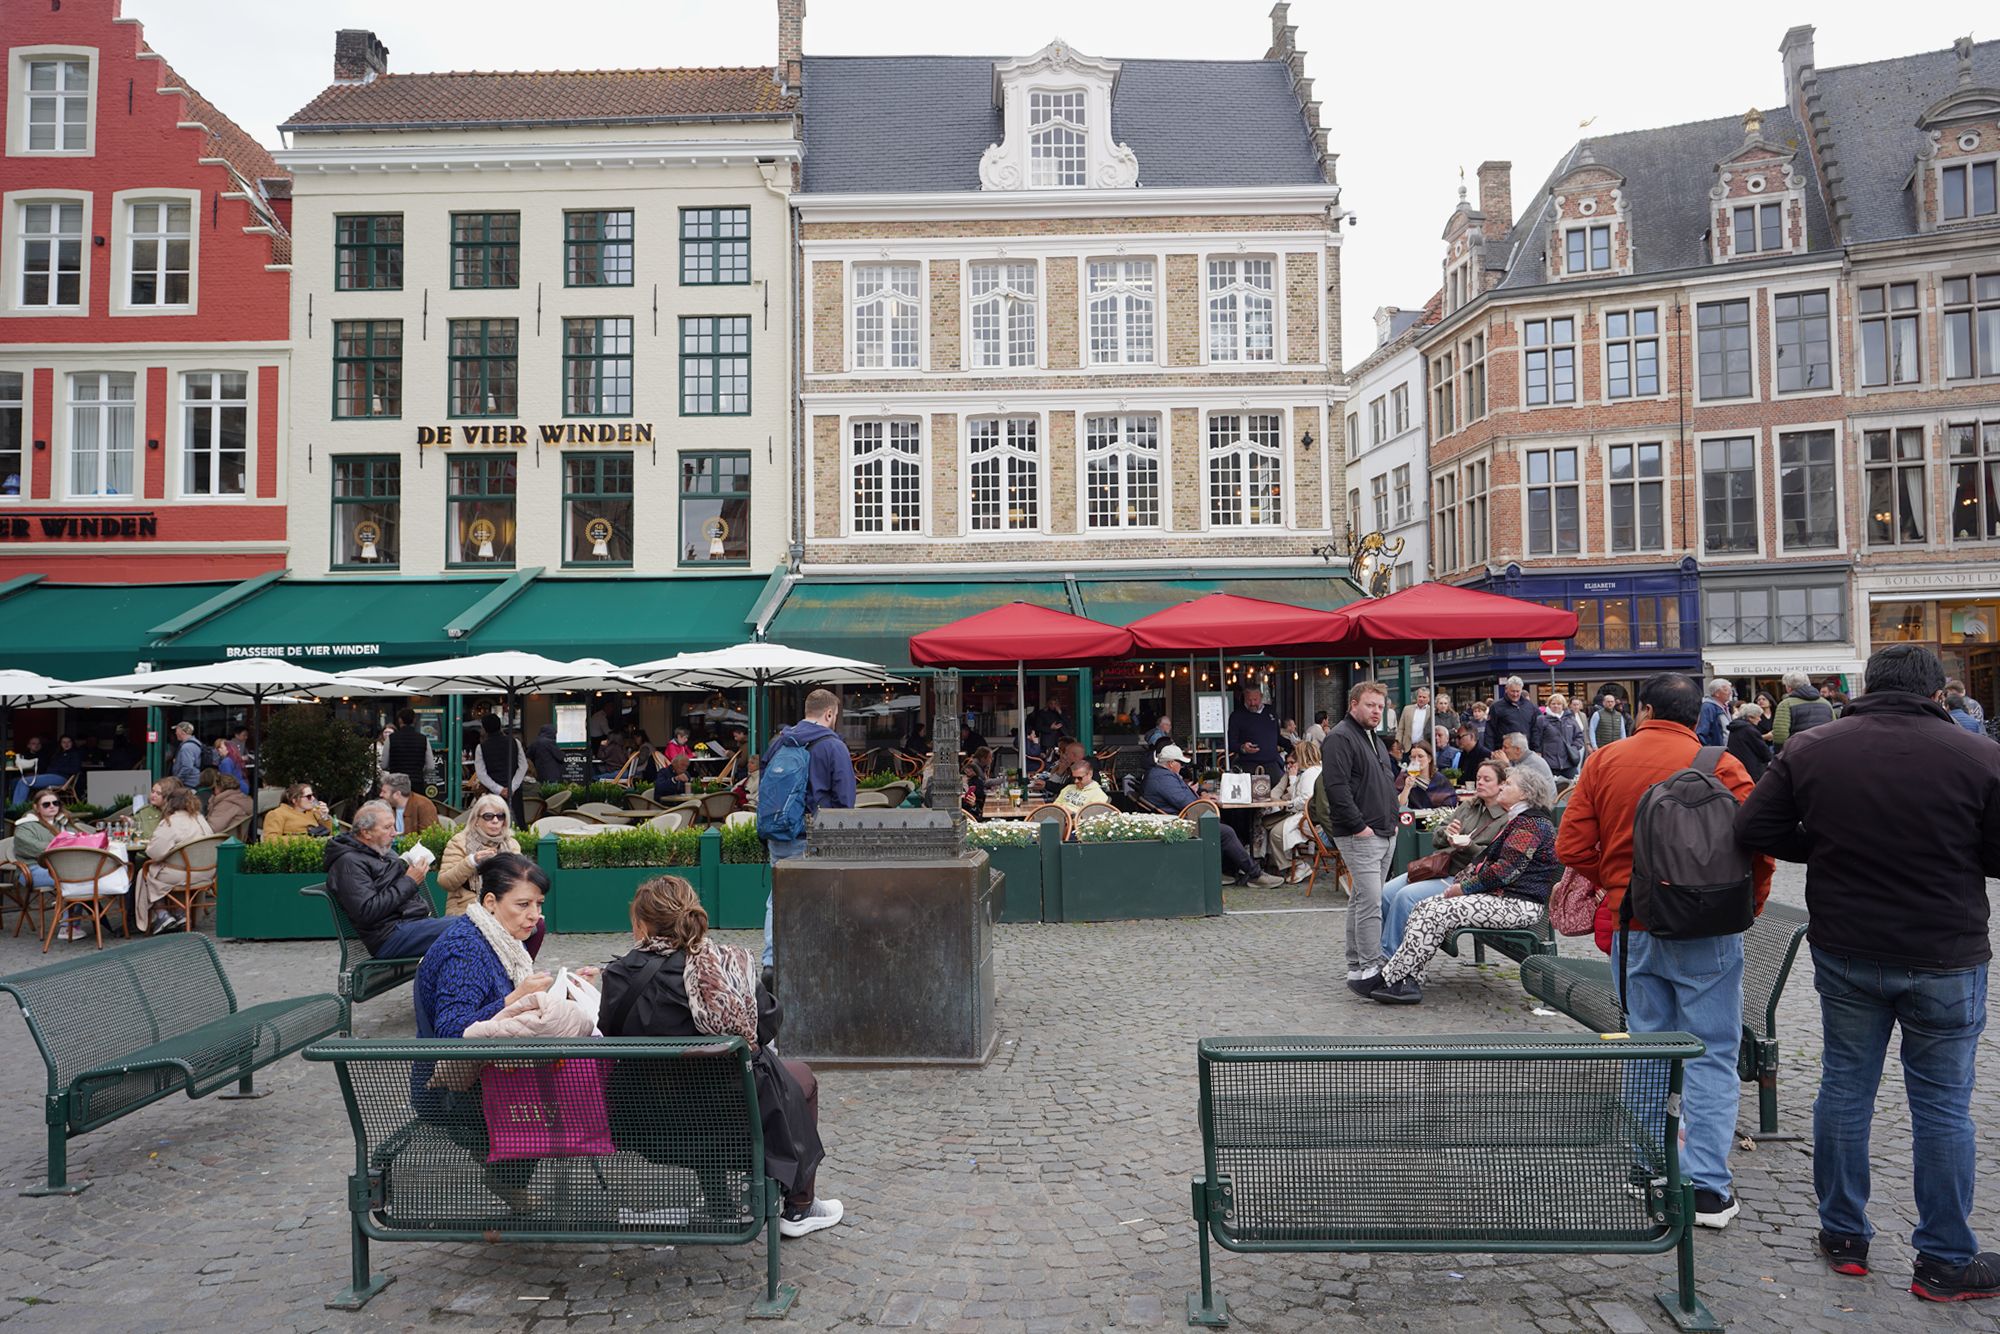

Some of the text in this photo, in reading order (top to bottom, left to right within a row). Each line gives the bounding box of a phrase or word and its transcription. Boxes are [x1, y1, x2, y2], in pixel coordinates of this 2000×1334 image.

[417, 423, 653, 445] DE VIER WINDEN
[40, 517, 158, 538] WINDEN
[1584, 582, 1616, 590] ELISABETH
[1885, 573, 1983, 586] BOEKHANDEL
[226, 644, 380, 658] BRASSERIE DE VIER WINDEN
[1733, 665, 1841, 674] BELGIAN HERITAGE
